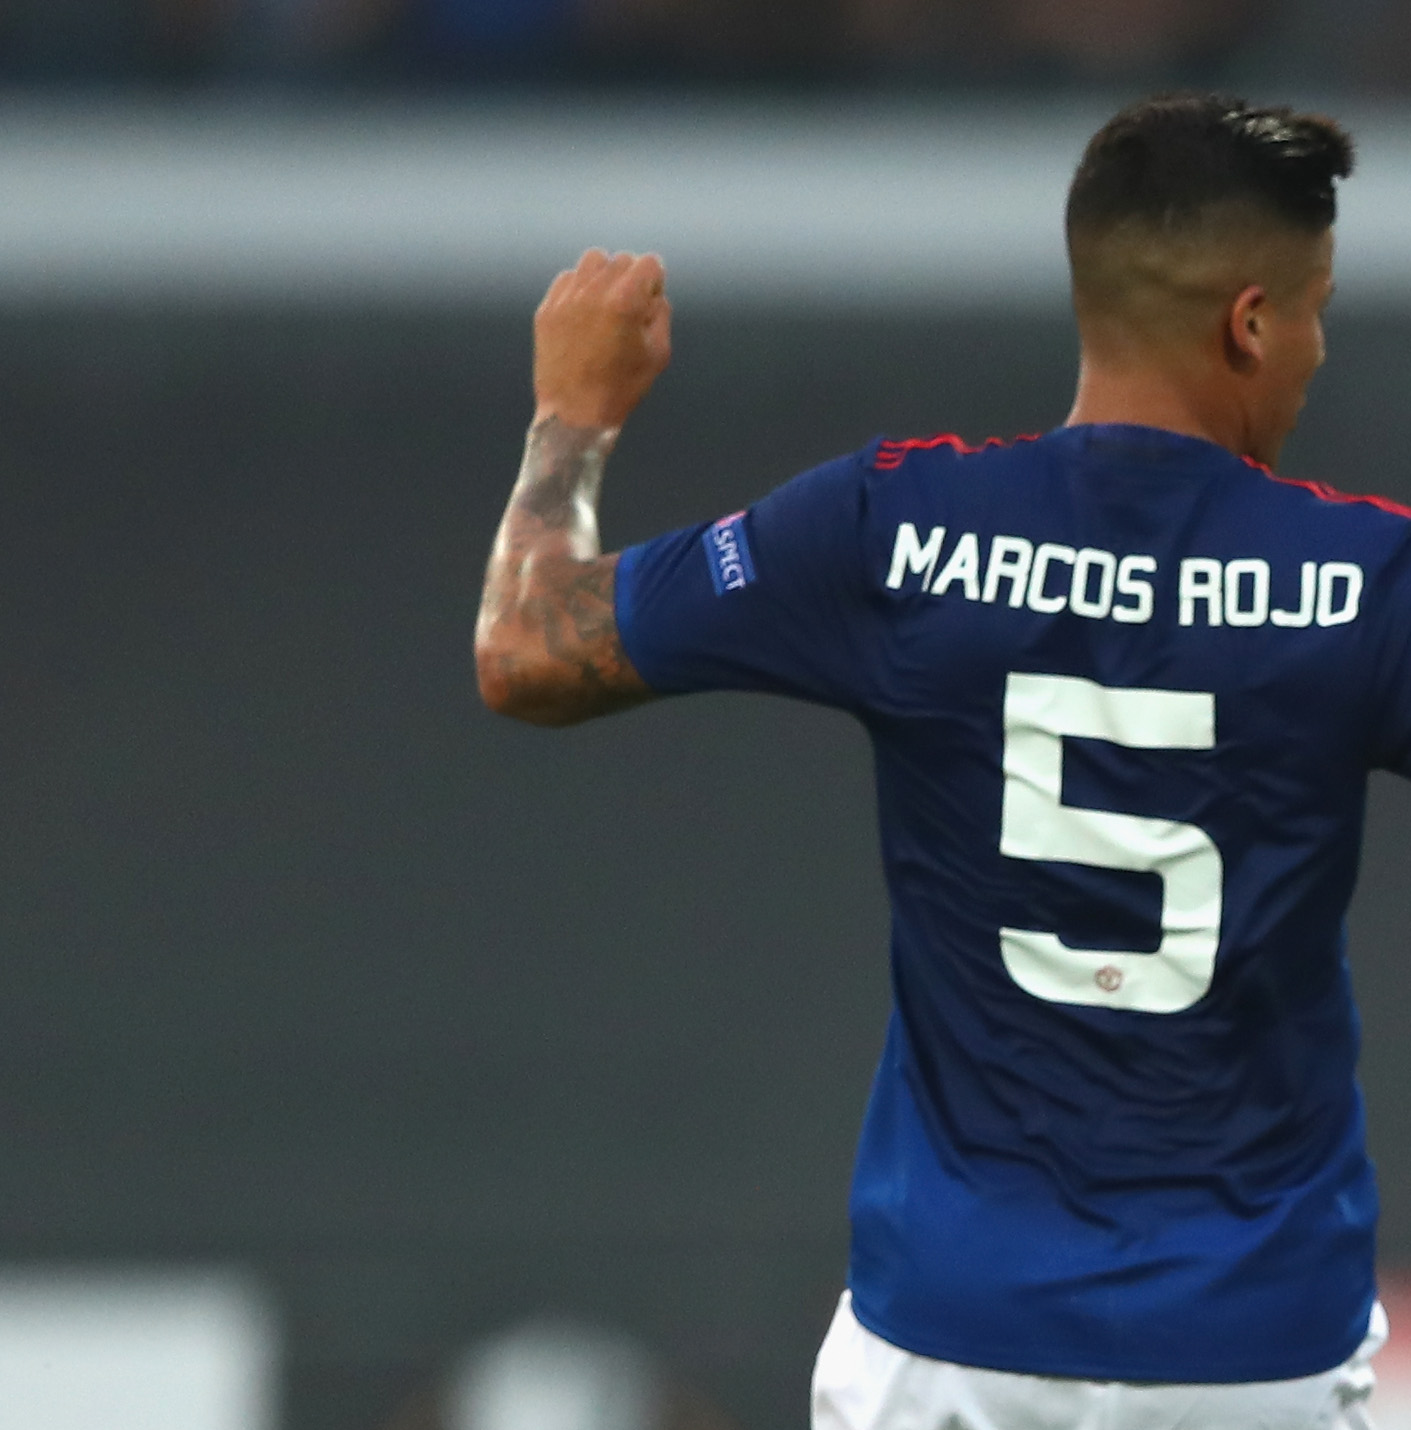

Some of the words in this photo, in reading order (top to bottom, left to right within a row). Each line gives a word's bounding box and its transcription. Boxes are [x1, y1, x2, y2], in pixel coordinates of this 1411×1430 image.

[886, 523, 1157, 625] MARCOS
[1179, 557, 1363, 628] ROJO
[1000, 671, 1223, 1014] 5
